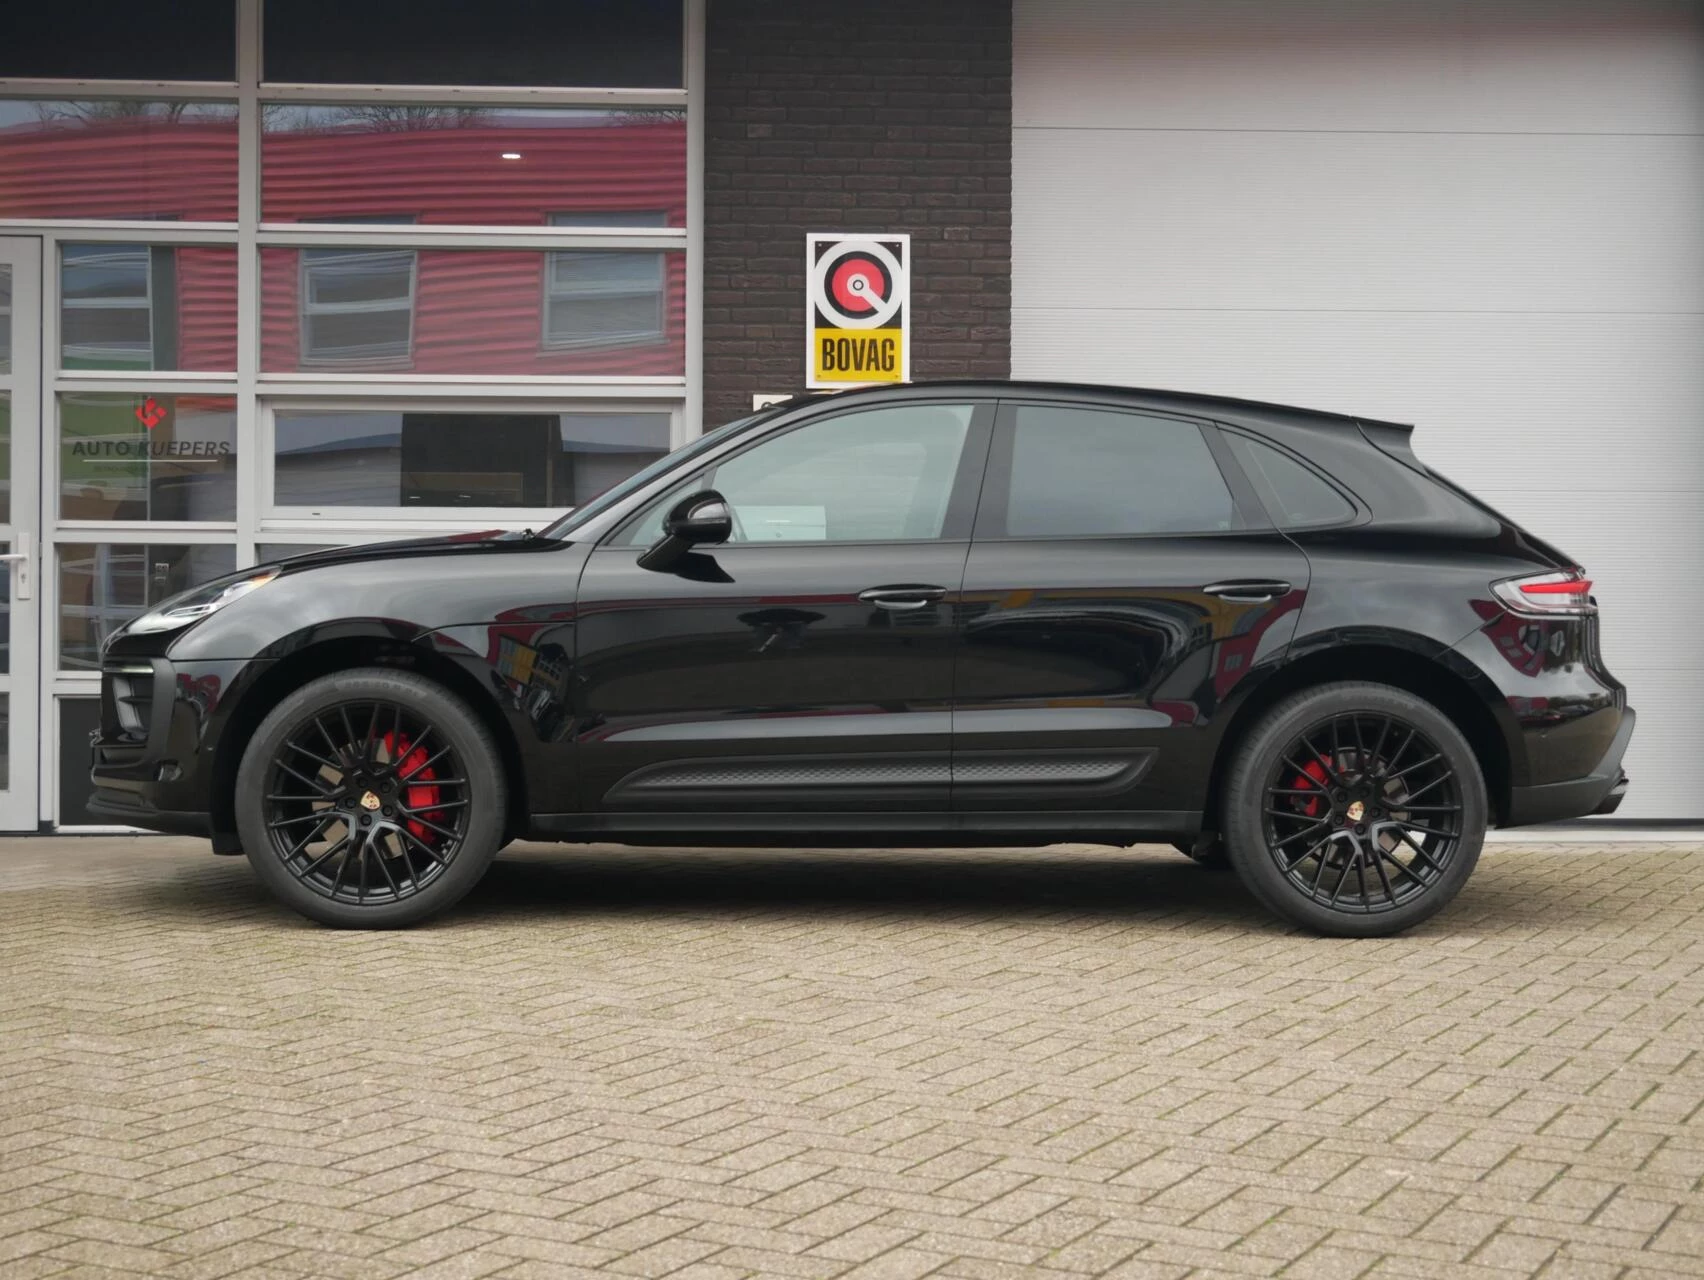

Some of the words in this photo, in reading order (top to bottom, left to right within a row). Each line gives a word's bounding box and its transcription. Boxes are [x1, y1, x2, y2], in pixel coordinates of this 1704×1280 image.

[822, 338, 894, 372] BOVAG
[72, 441, 130, 456] AUTO
[138, 441, 231, 456] KUEPERS
